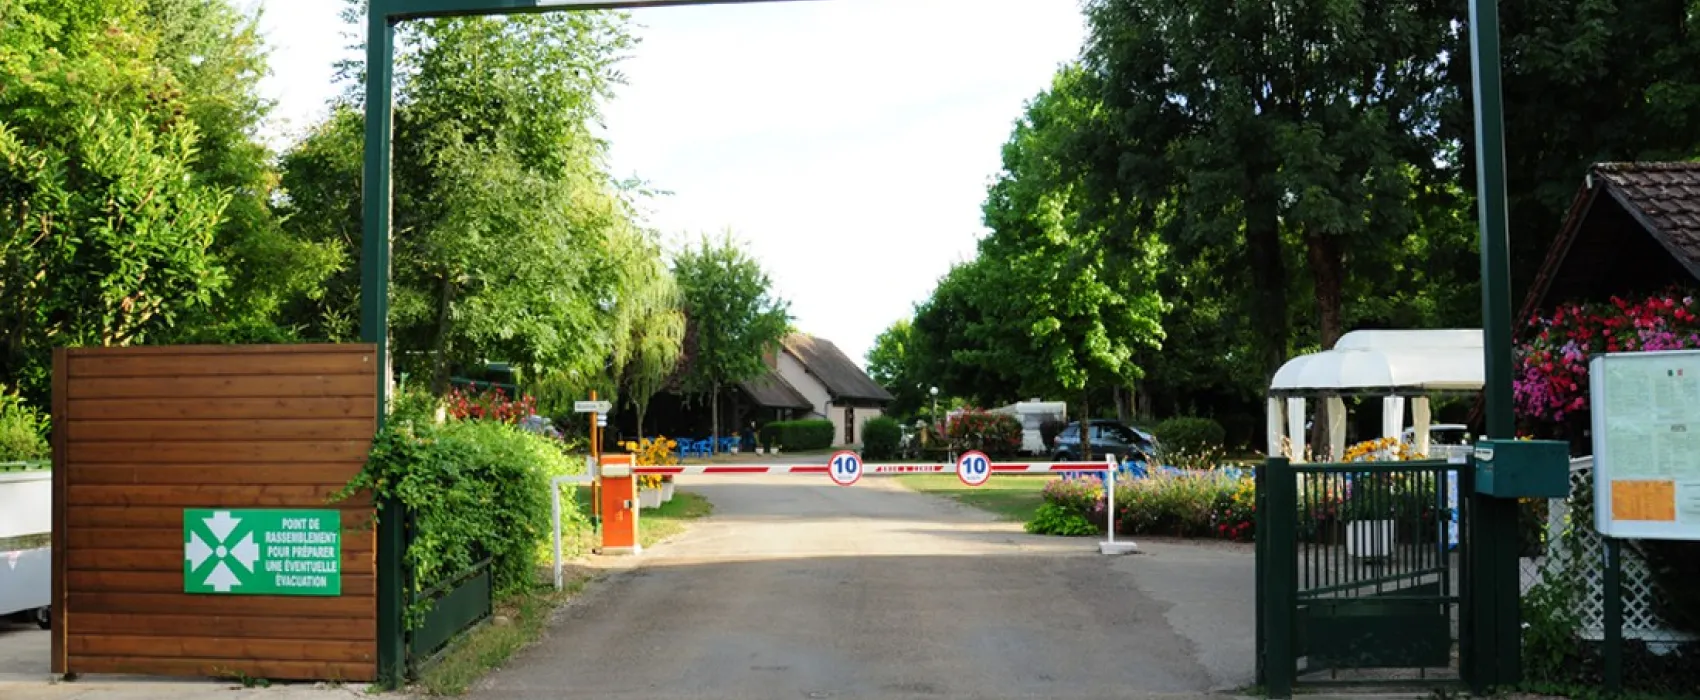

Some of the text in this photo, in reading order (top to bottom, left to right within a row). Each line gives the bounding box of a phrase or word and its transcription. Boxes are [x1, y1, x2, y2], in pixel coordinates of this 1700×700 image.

[833, 456, 857, 474] 10
[962, 456, 986, 474] 10
[282, 517, 320, 530] POINT DE
[265, 531, 337, 544] RASSEMBLEMENT
[267, 544, 335, 558] POUR PRÉPARER
[265, 558, 337, 573] UNE ÉVENTUELLE
[275, 572, 327, 588] ÉVACUATION
